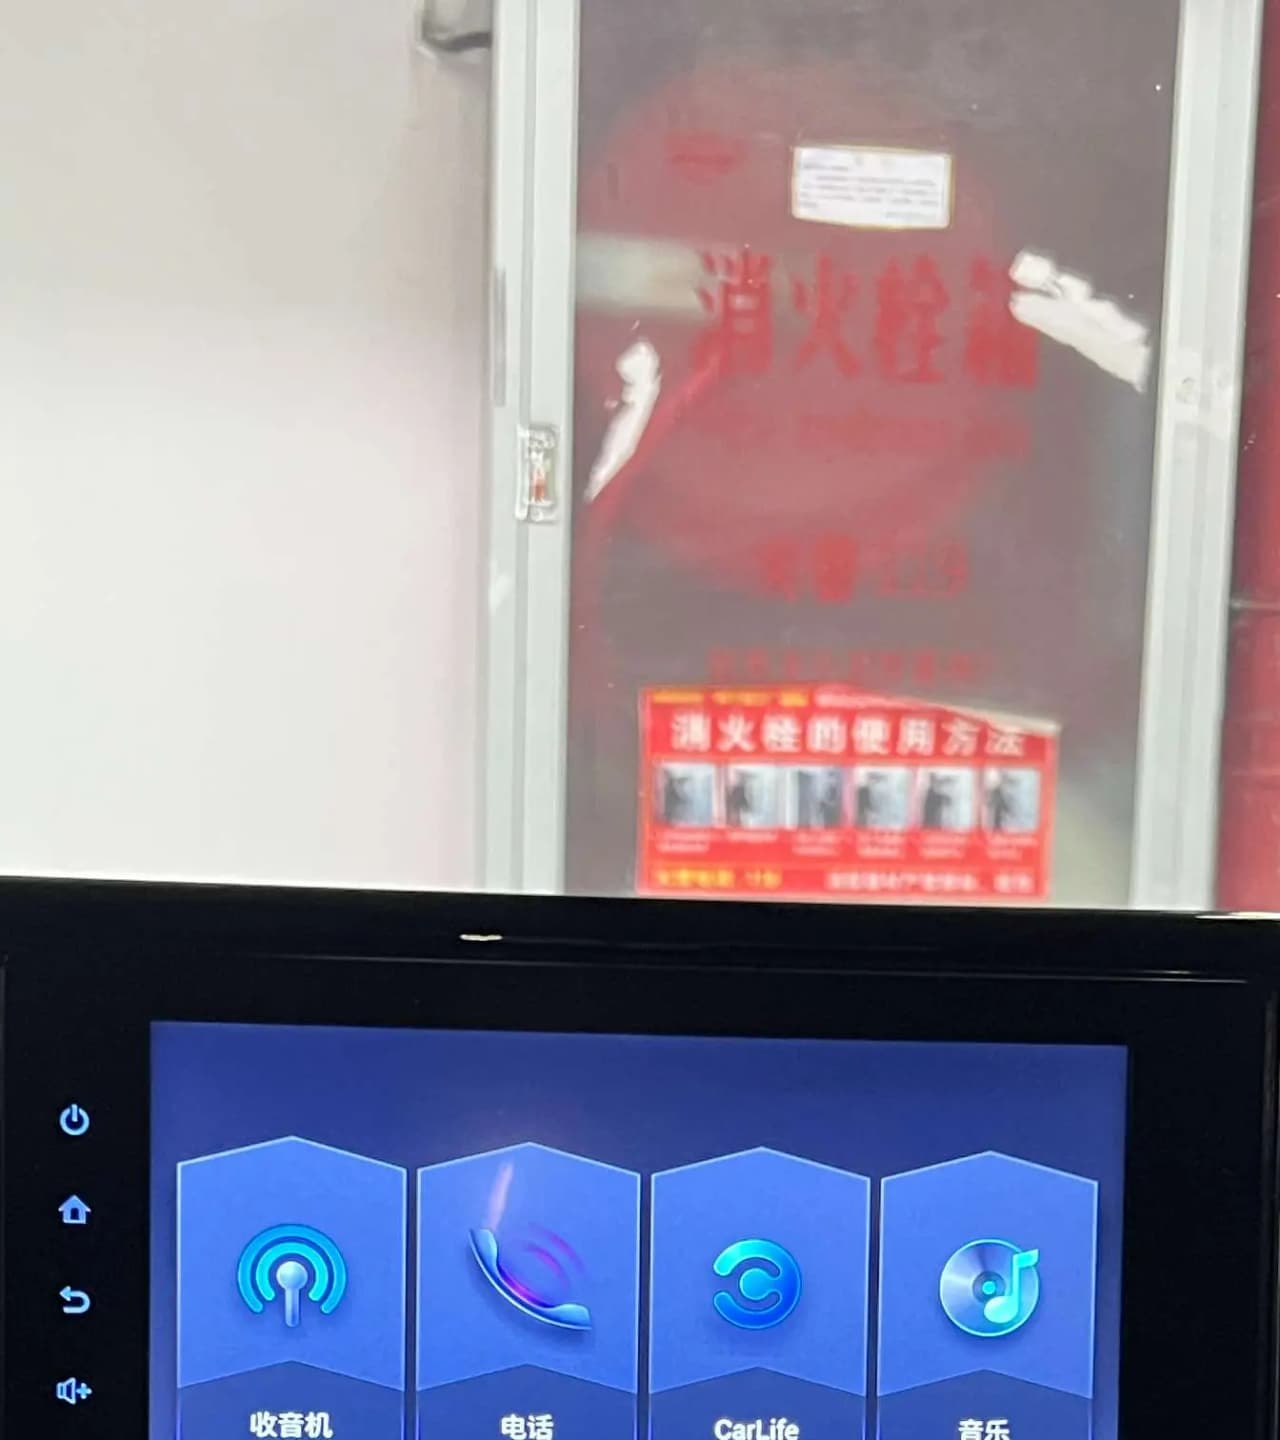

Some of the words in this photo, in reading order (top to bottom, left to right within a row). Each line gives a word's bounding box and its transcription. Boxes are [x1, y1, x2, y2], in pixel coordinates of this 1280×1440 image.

[249, 1410, 333, 1440] 收音机
[500, 1413, 554, 1440] 电话
